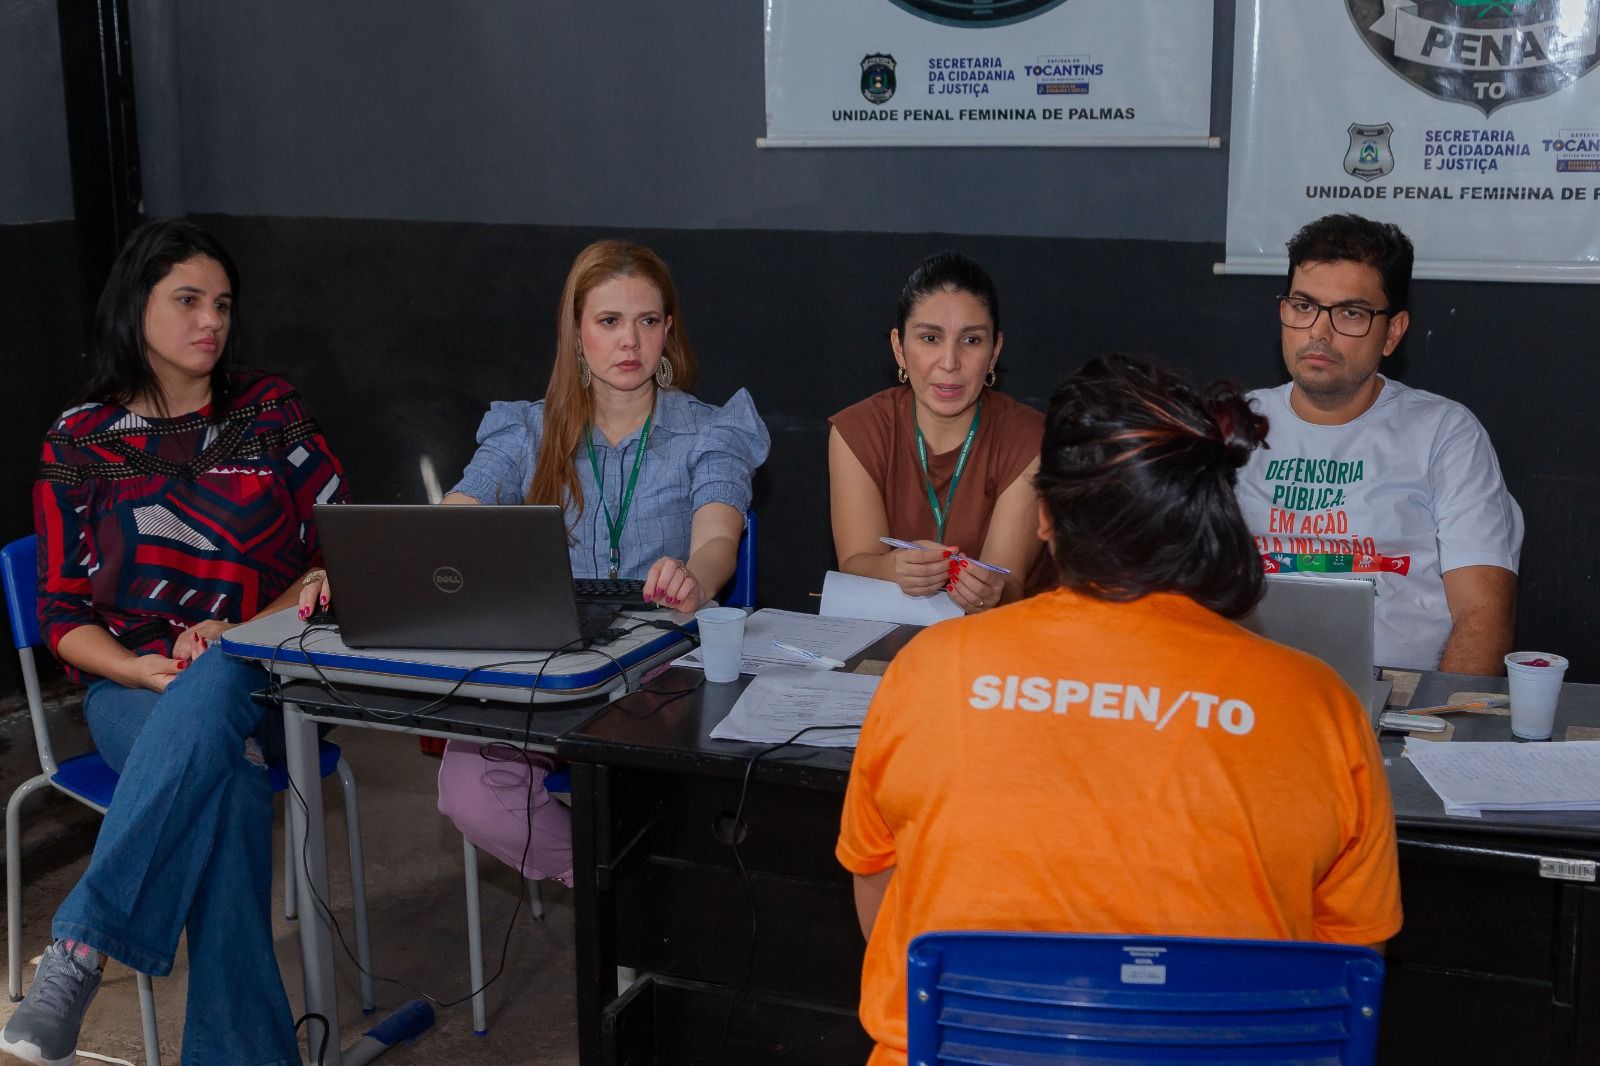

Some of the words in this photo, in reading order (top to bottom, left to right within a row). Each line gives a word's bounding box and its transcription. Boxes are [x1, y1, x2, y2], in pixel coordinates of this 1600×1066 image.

[928, 57, 1002, 69] SECRETARIA
[1024, 64, 1104, 76] TOCANTINS
[928, 71, 945, 82] DA
[948, 70, 1015, 81] CIDADANIA
[928, 84, 935, 94] E
[938, 83, 989, 98] JUSTIÇA
[1473, 82, 1506, 100] TO
[832, 109, 898, 121] UNIDADE
[903, 109, 954, 121] PENAL
[959, 108, 1037, 120] FEMININA
[1042, 108, 1064, 120] DE
[1068, 107, 1135, 120] PALMAS
[1425, 130, 1515, 142] SECRETARIA
[1424, 144, 1444, 156] DA
[1448, 144, 1531, 156] CIDADANIA
[1424, 158, 1431, 170] E
[1436, 158, 1498, 174] JUSTIÇA
[1305, 186, 1387, 199] UNIDADE
[1393, 186, 1453, 199] PENAL
[1460, 187, 1554, 200] FEMININA
[1561, 187, 1587, 200] DE
[1265, 458, 1364, 484] DEFENSORIA
[1272, 482, 1347, 511] PÚBLICA:
[1269, 508, 1296, 534] EM
[1300, 509, 1348, 538] AÇÃO
[969, 674, 1256, 736] SISPEN/TO
